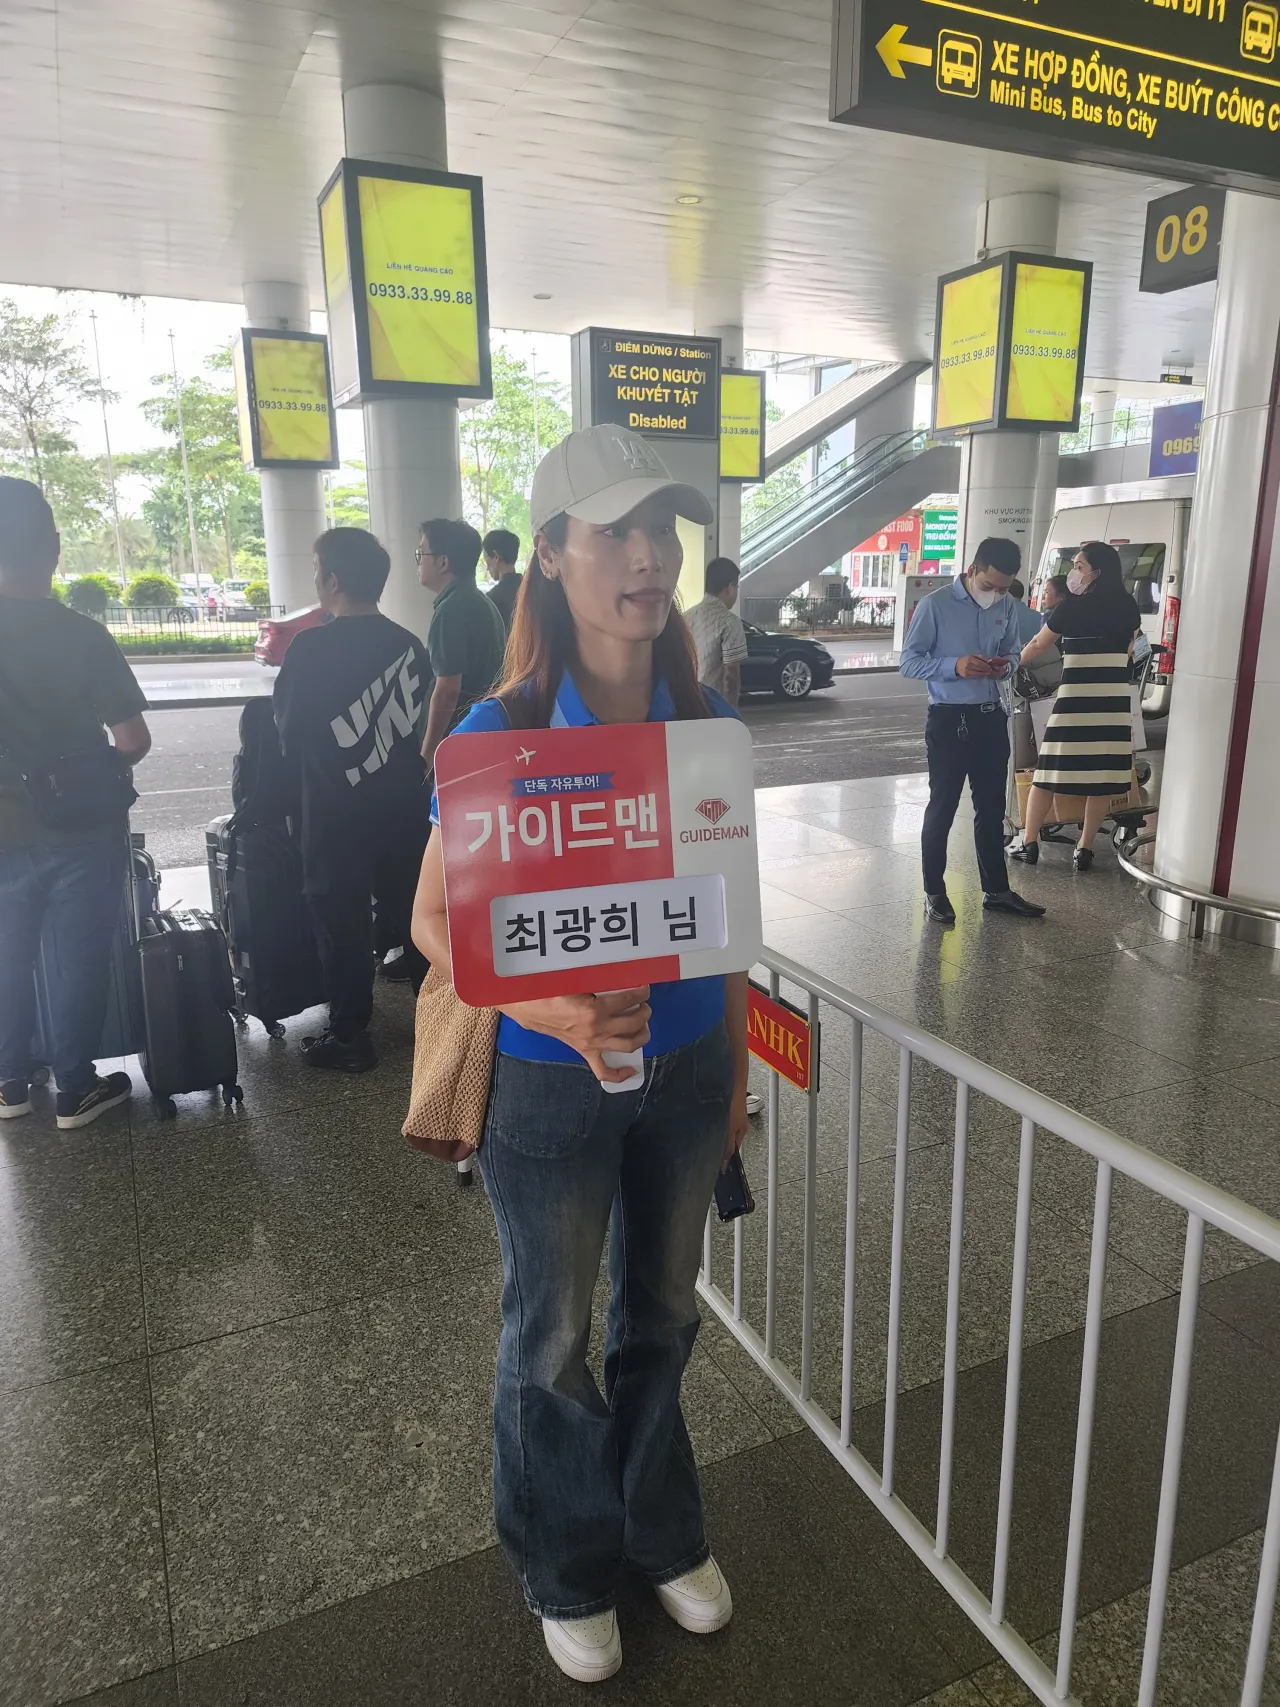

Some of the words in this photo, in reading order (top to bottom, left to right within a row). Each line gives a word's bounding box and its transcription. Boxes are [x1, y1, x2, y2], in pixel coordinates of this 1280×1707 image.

[991, 40, 1020, 76] XE
[1024, 47, 1067, 90] HỢP
[1071, 49, 1131, 105] ĐỒNG,
[1136, 72, 1162, 105] XE
[1165, 78, 1213, 116] BUÝT
[1215, 87, 1265, 128] CÔNG
[990, 79, 1025, 109] Mini
[1029, 87, 1067, 120] Bus,
[1071, 96, 1103, 124] Bus
[1106, 104, 1123, 127] to
[1126, 107, 1157, 139] City
[1155, 205, 1208, 263] 08
[369, 282, 473, 305] 0933.33.99.88
[615, 341, 640, 354] ĐIỂM
[642, 343, 673, 357] DỪNG
[674, 347, 678, 357] /
[679, 347, 711, 359] Station
[940, 345, 995, 369] 0933.33.99.88
[1012, 344, 1077, 360] 0933.33.99.88
[608, 364, 627, 379] XE
[630, 367, 659, 382] CHO
[662, 368, 706, 385] NGƯỜI
[617, 383, 671, 403] KHUYẾT
[674, 389, 699, 407] TẬT
[258, 400, 327, 413] 0933.33.99.88
[629, 412, 687, 430] Disabled
[897, 519, 914, 533] FOOD
[525, 779, 547, 793] 단독
[550, 775, 600, 792] 자유투어!
[465, 793, 659, 862] 가이드맨
[680, 825, 749, 843] GUIDEMAN
[505, 902, 639, 956] 최광희
[662, 896, 697, 942] 님
